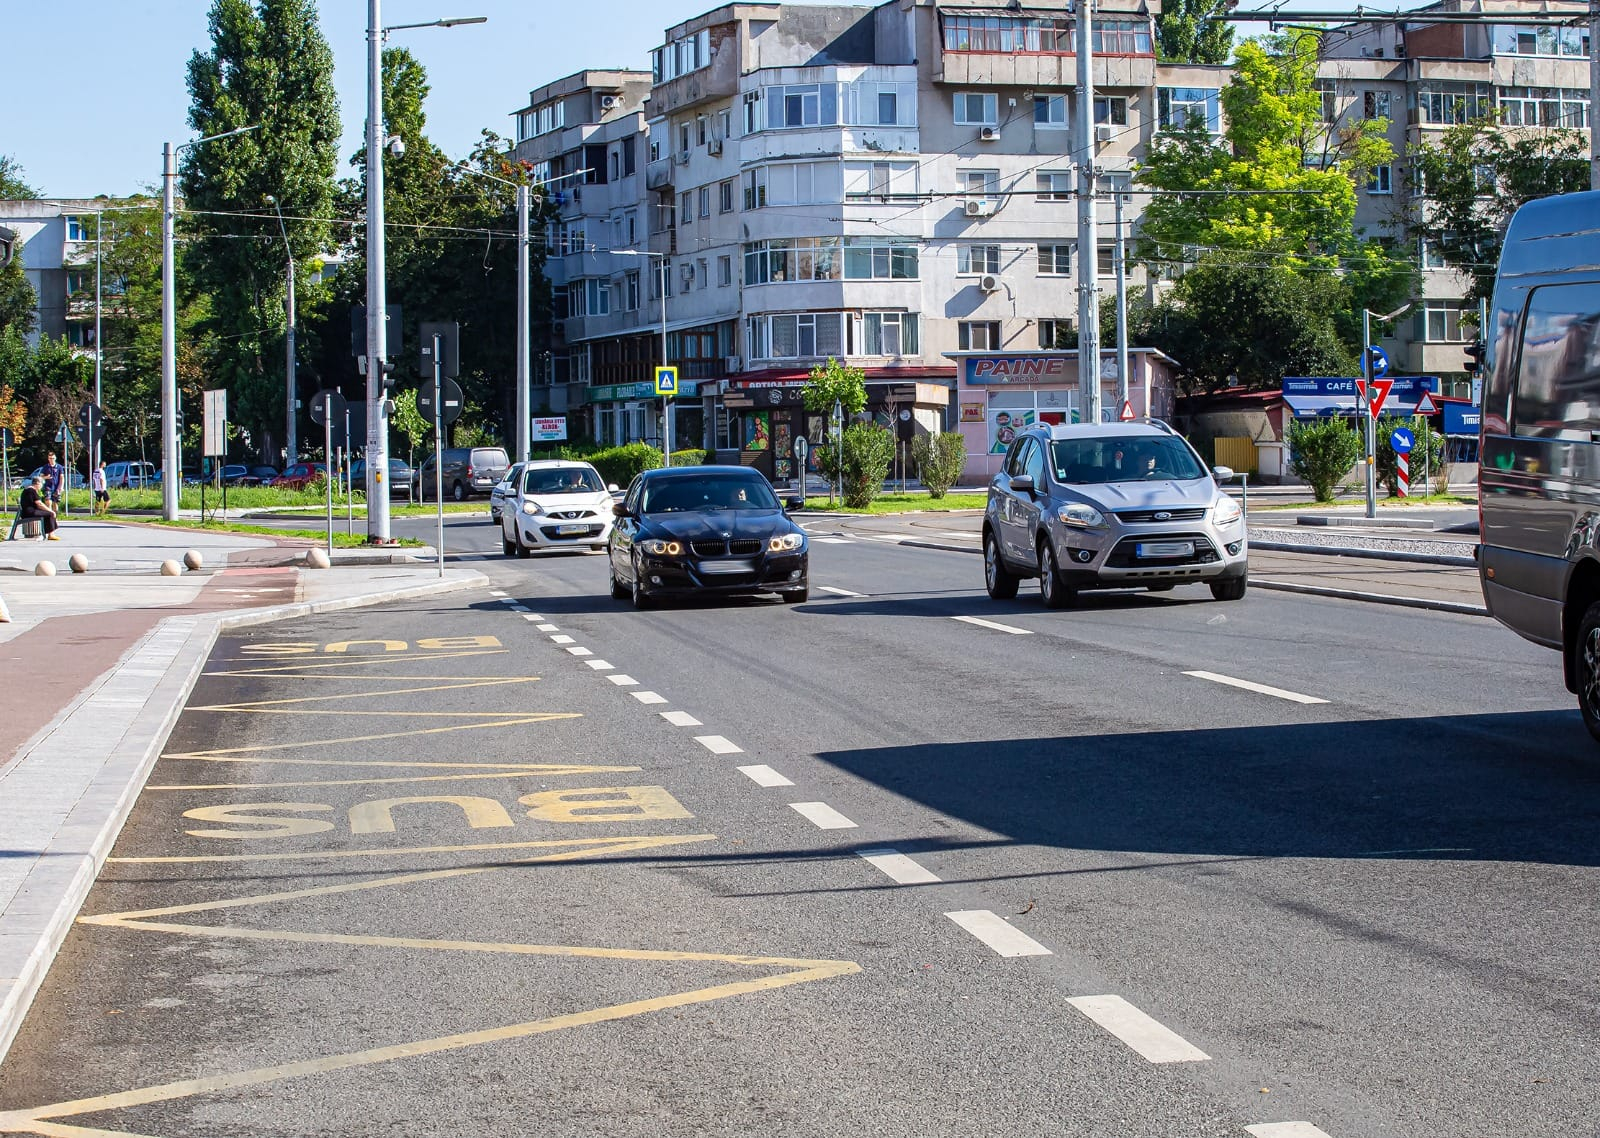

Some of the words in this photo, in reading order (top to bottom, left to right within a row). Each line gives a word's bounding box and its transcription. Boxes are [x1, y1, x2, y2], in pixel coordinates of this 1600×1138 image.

[974, 358, 1064, 377] PAINE
[1326, 381, 1353, 391] CAFÉ
[239, 635, 503, 655] BUS
[182, 785, 695, 840] BUS
